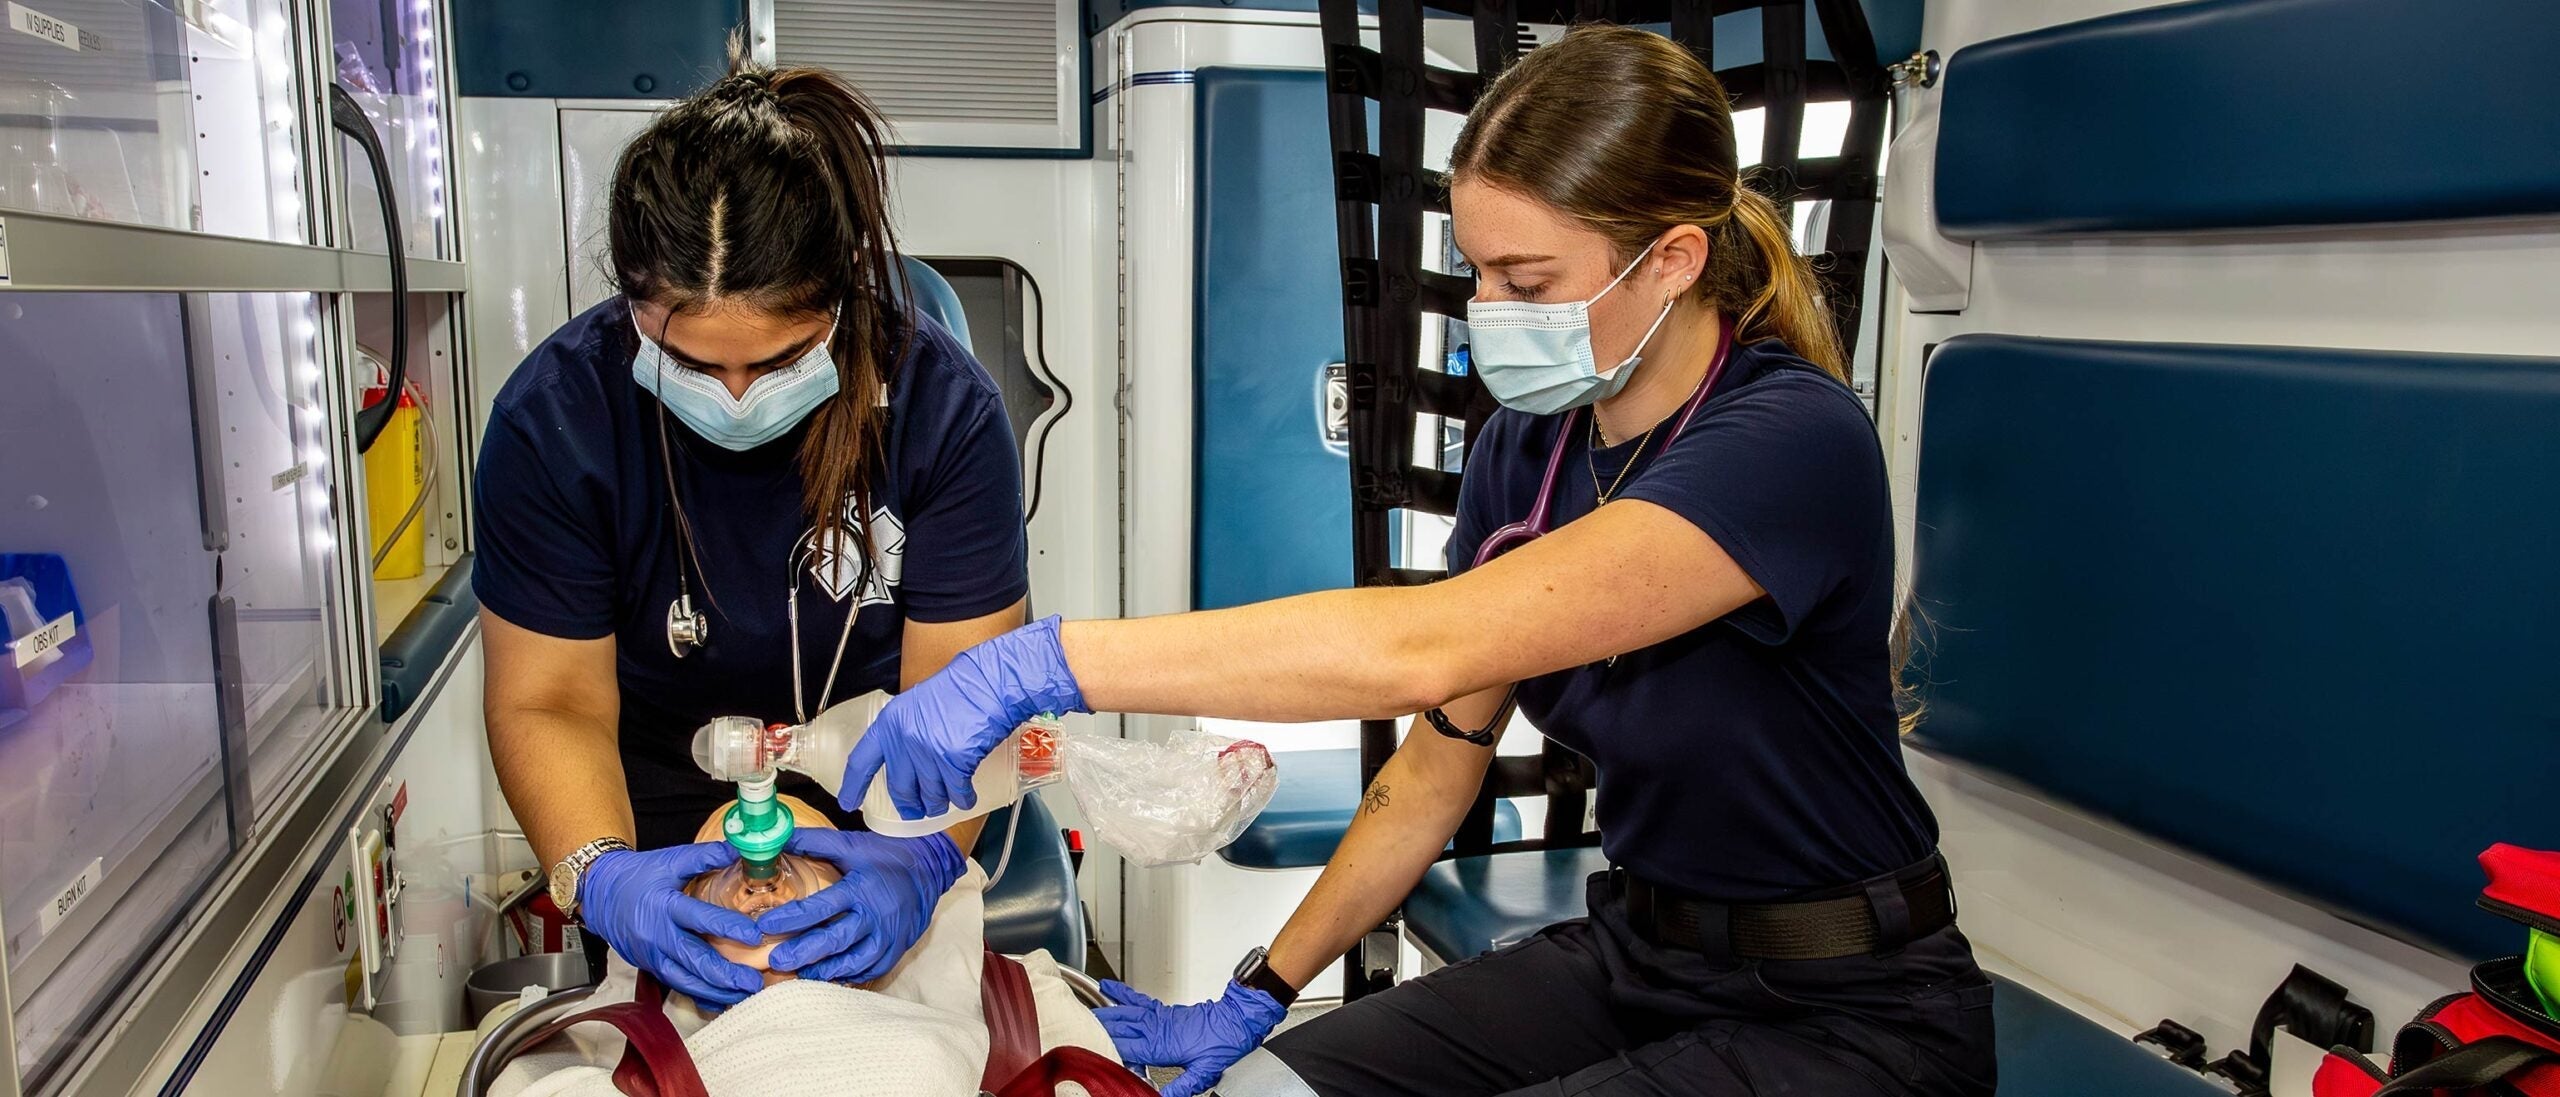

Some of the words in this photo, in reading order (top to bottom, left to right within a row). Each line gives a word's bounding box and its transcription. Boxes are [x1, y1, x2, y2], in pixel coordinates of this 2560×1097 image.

[25, 13, 33, 31] IV
[33, 15, 65, 42] SUPPLIES
[33, 631, 48, 654] OBS
[48, 624, 59, 645] KIT
[57, 884, 77, 916] BURN
[76, 874, 87, 898] KIT
